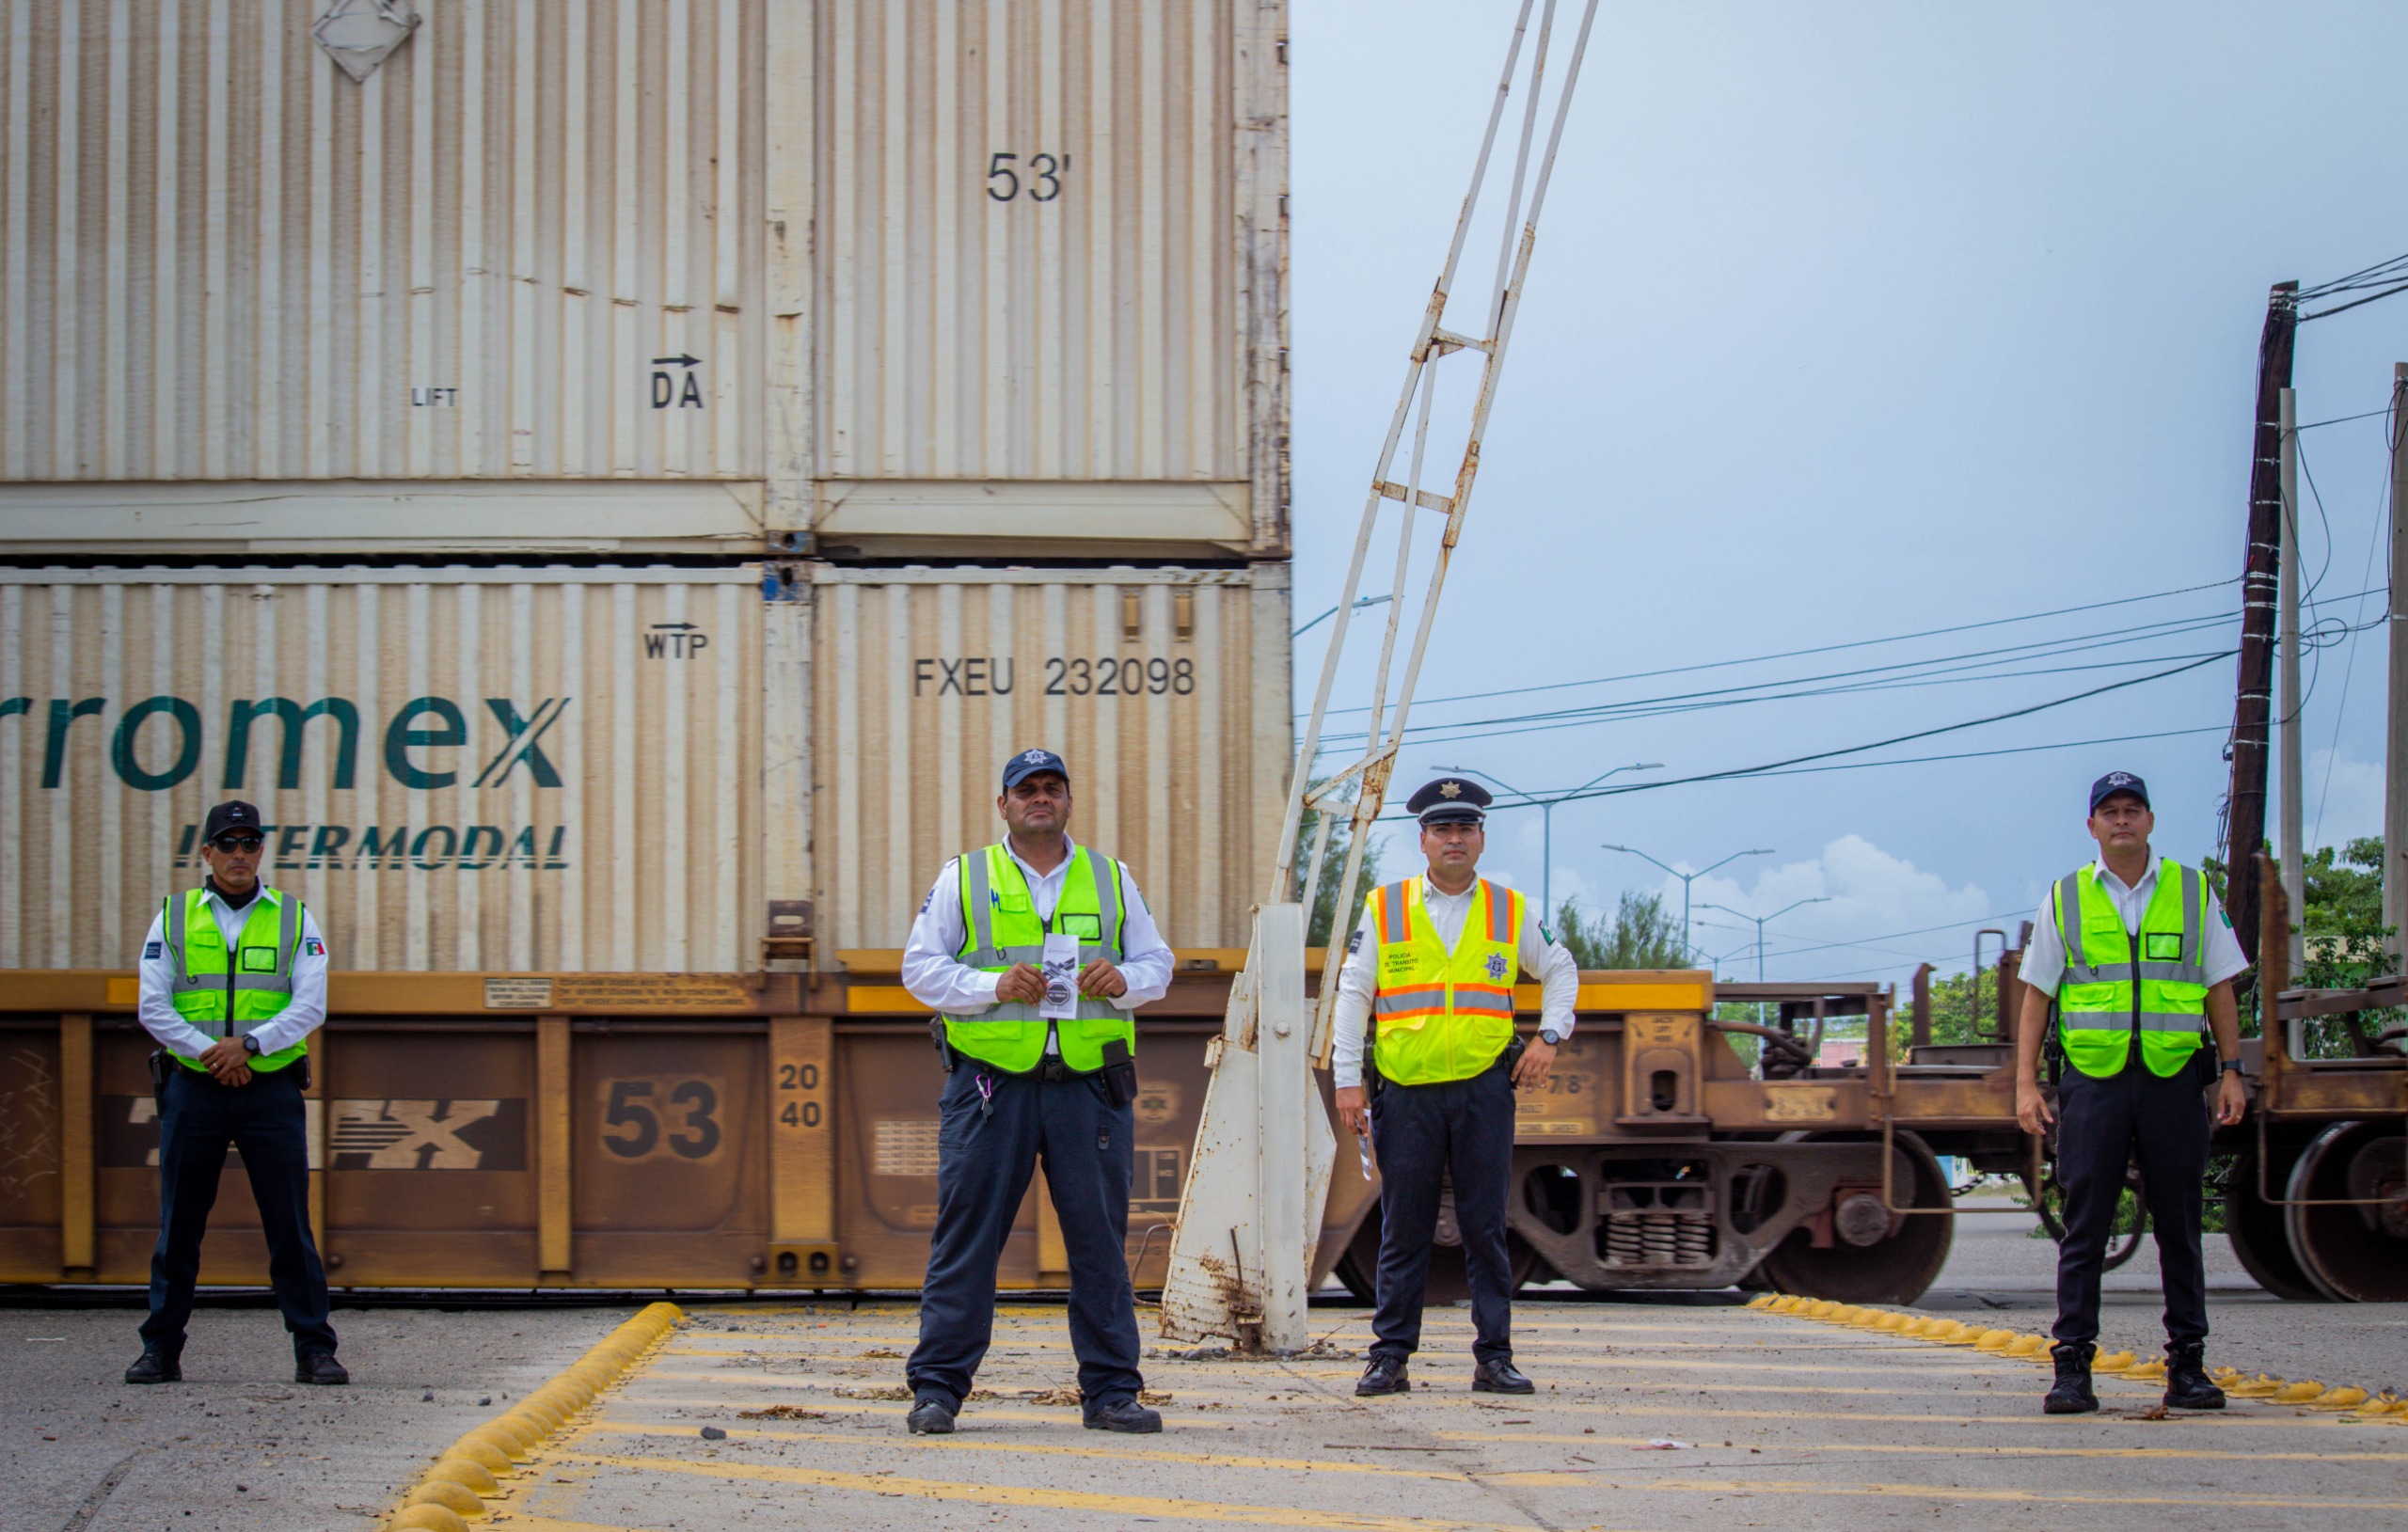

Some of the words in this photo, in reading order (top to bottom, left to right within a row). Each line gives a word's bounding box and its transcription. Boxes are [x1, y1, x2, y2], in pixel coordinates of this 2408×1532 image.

[986, 152, 1071, 202] 53'
[411, 387, 457, 407] LIFT
[651, 371, 704, 409] DA
[643, 633, 708, 659] WTP
[914, 656, 1014, 697] FXEU
[1045, 656, 1196, 697] 232098
[779, 1064, 818, 1090] 20
[602, 1081, 721, 1159] 53
[780, 1101, 820, 1128] 40
